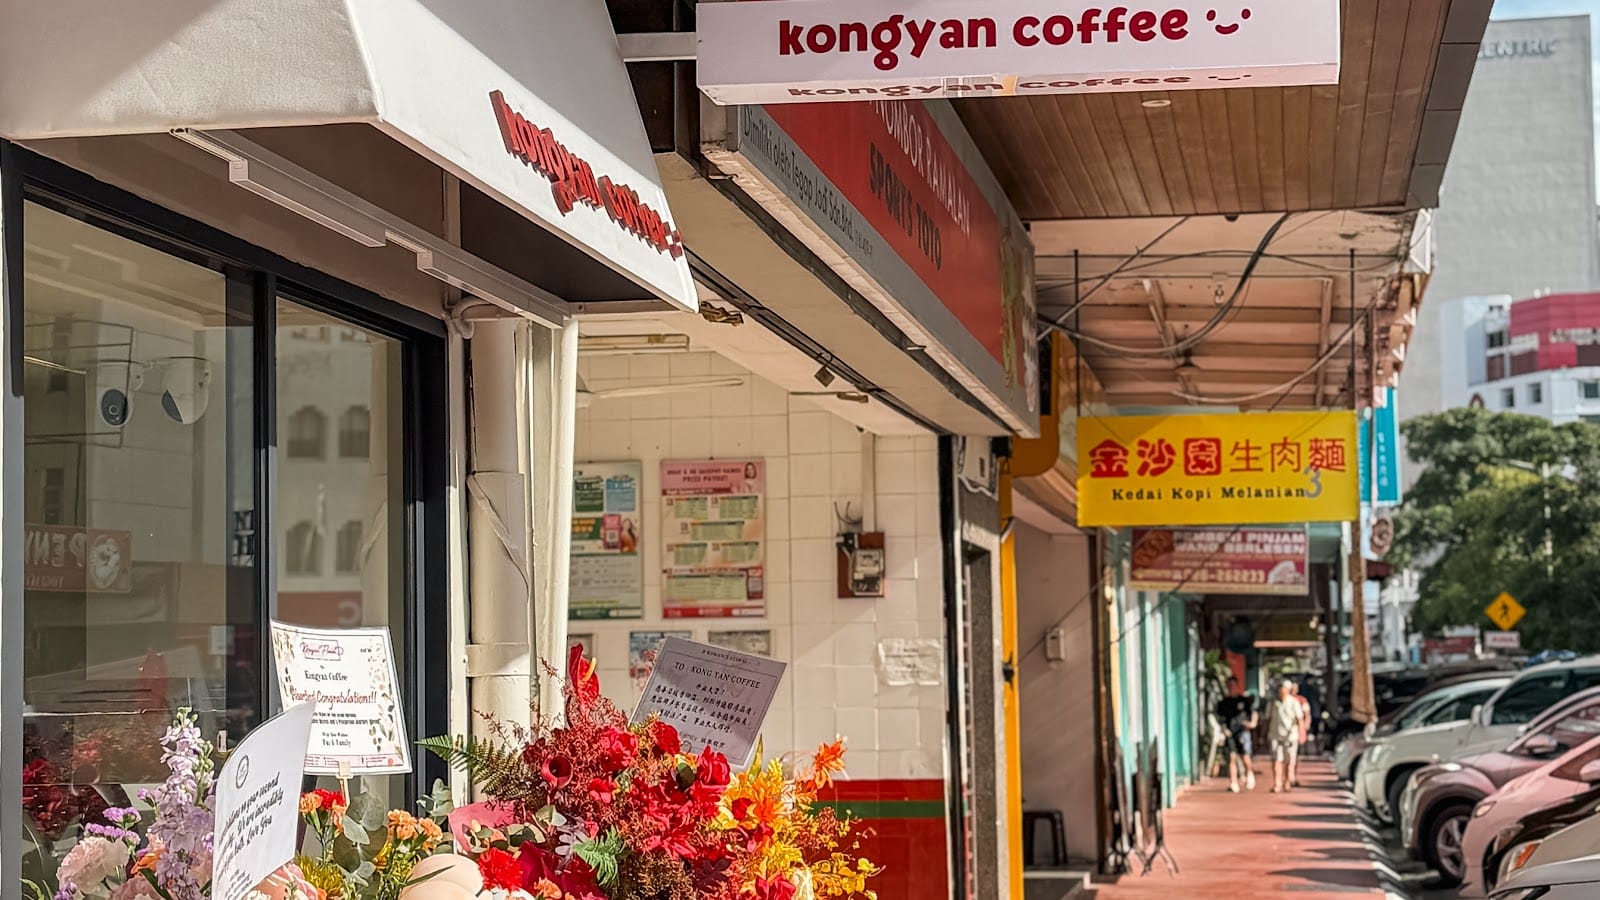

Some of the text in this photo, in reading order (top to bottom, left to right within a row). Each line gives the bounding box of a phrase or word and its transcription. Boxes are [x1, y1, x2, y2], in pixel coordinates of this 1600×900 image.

[779, 7, 1189, 71] kongyan coffee
[788, 76, 1191, 97] kongyan coffee
[489, 90, 669, 255] kongyan coffee
[869, 142, 942, 271] SPORTS TOTO
[1112, 488, 1162, 501] Kedai
[1172, 487, 1211, 502] Kopi
[1221, 486, 1305, 499] Melanian
[1247, 532, 1305, 544] PINJAM
[674, 661, 761, 689] TO KONG YAN COFFEE
